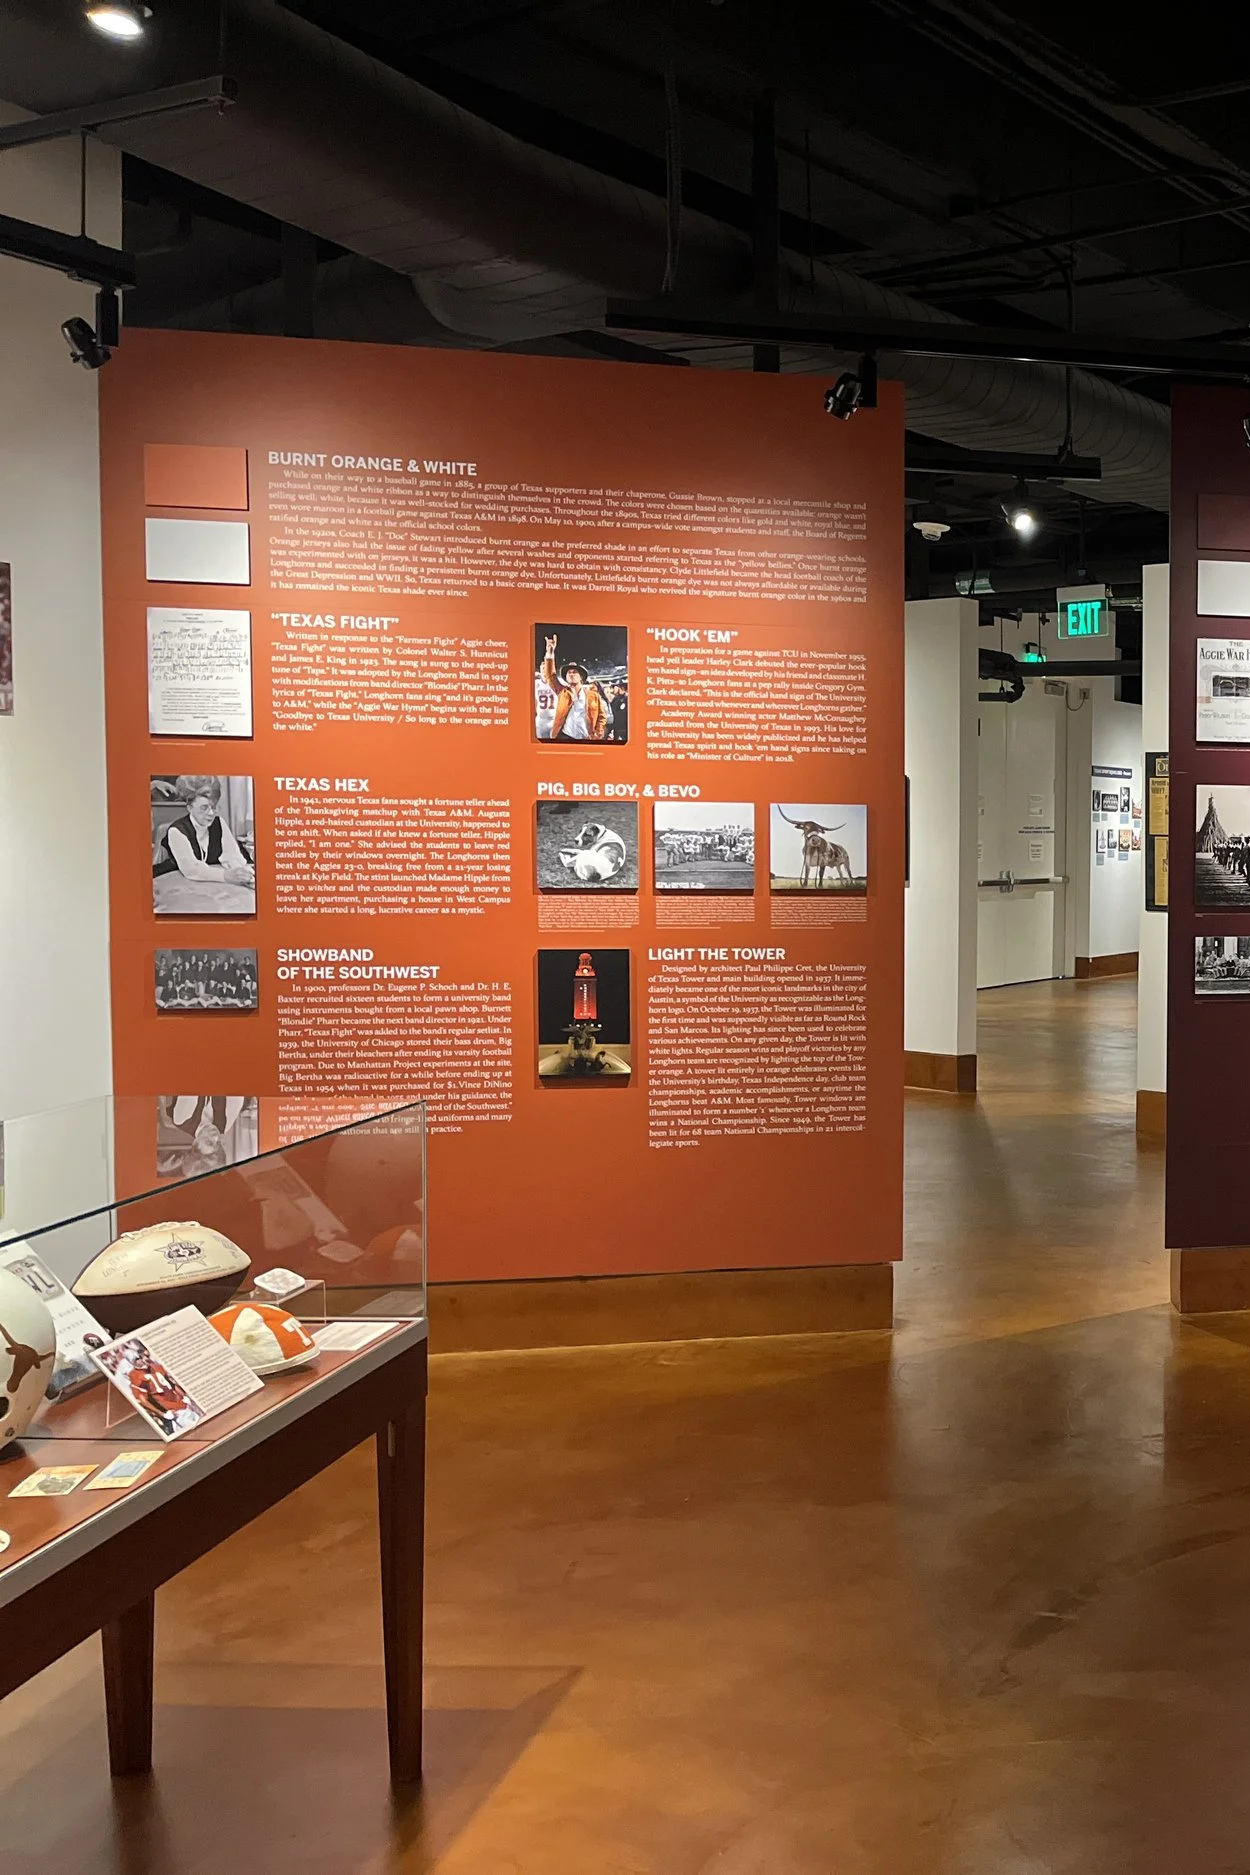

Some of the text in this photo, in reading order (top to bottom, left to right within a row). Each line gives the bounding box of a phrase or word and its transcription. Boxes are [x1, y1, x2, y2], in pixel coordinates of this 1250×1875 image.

[268, 451, 477, 476] BURNT ORANGE & WHITE
[270, 613, 399, 630] “TEXAS FIGHT”
[1067, 601, 1102, 636] EXIT
[285, 631, 508, 648] Written in response to the “Farmers Fight” Aggie cheer,
[646, 628, 738, 643] “HOOK ‘EM”
[1227, 649, 1245, 661] WAR
[539, 695, 555, 710] 91
[273, 777, 369, 792] TEXAS HEX
[537, 782, 701, 798] PIG, BIG BOY, & BEVO
[289, 795, 299, 805] In
[356, 796, 380, 805] Texas
[380, 796, 399, 805] fans
[399, 797, 427, 807] sought
[434, 798, 464, 806] fortune
[465, 798, 486, 807] teller
[486, 798, 510, 807] ahead
[277, 948, 374, 961] SHOWBAND
[648, 947, 786, 961] LIGHT THE TOWER
[277, 966, 440, 979] OF THE SOUTHWEST
[661, 964, 867, 974] Designed by architect Paul Philippe Cret, the University
